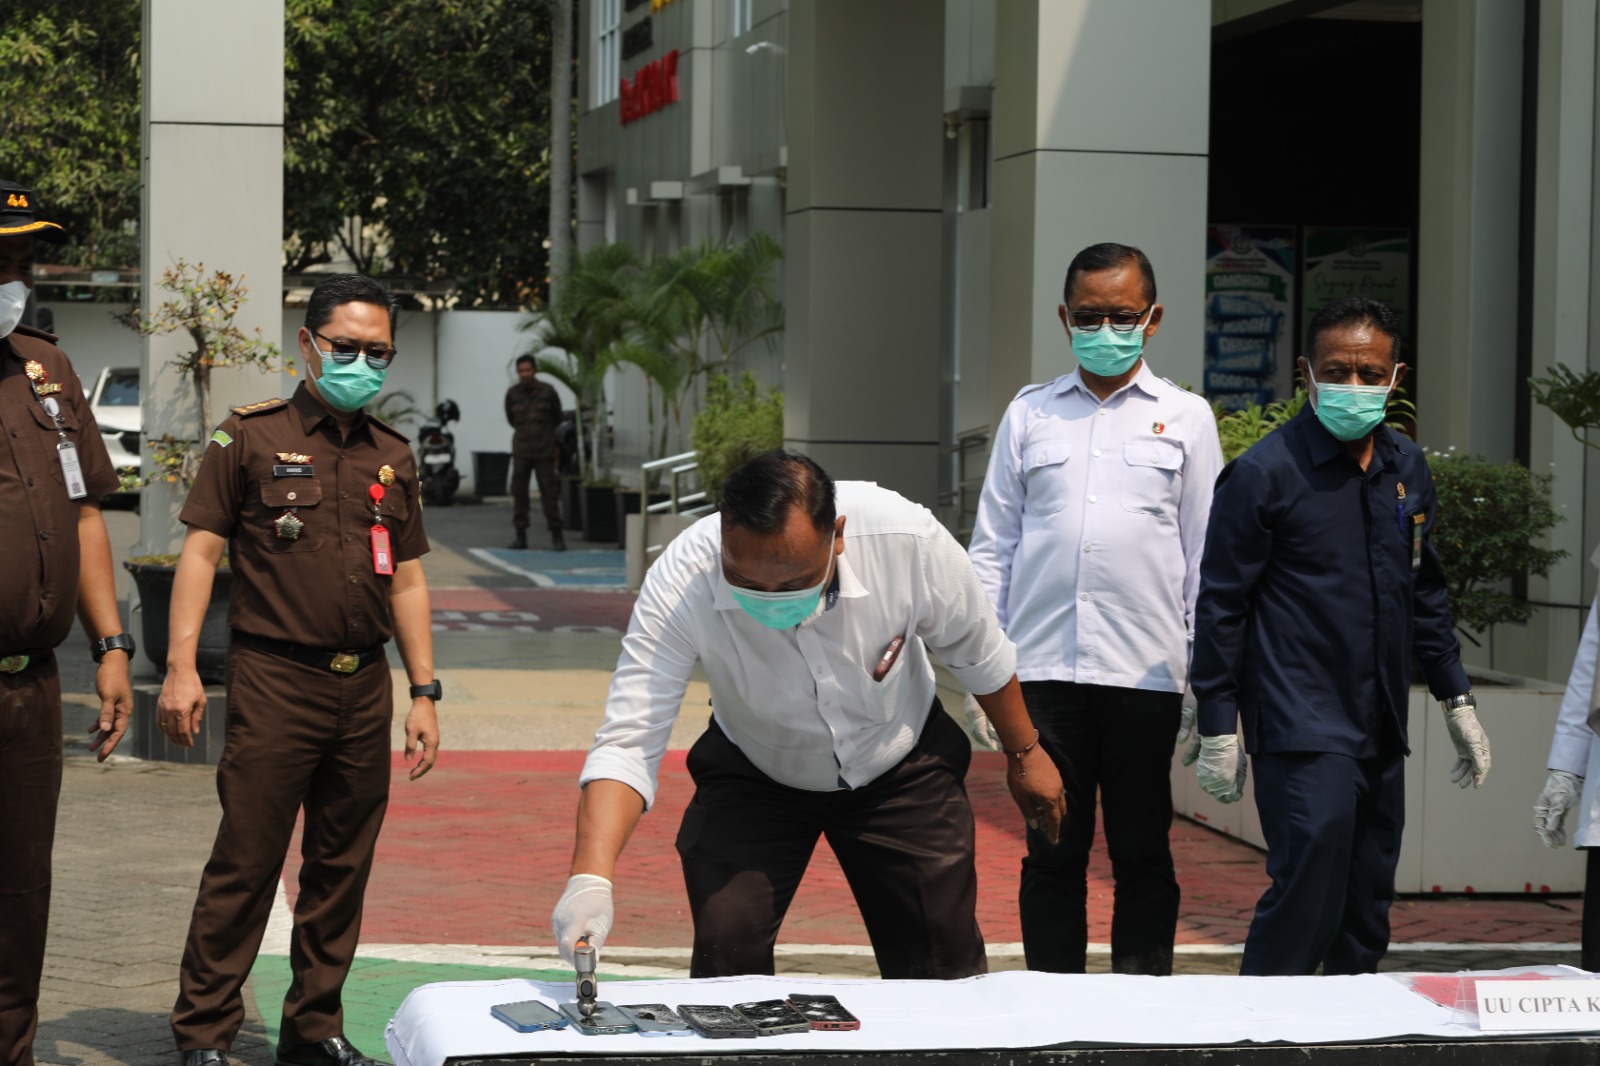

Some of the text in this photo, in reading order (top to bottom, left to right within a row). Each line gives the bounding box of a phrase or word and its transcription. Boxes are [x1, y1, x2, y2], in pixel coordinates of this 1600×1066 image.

[1212, 274, 1270, 290] AMANAH
[1484, 997, 1512, 1014] UU
[1518, 997, 1581, 1014] CIPTA
